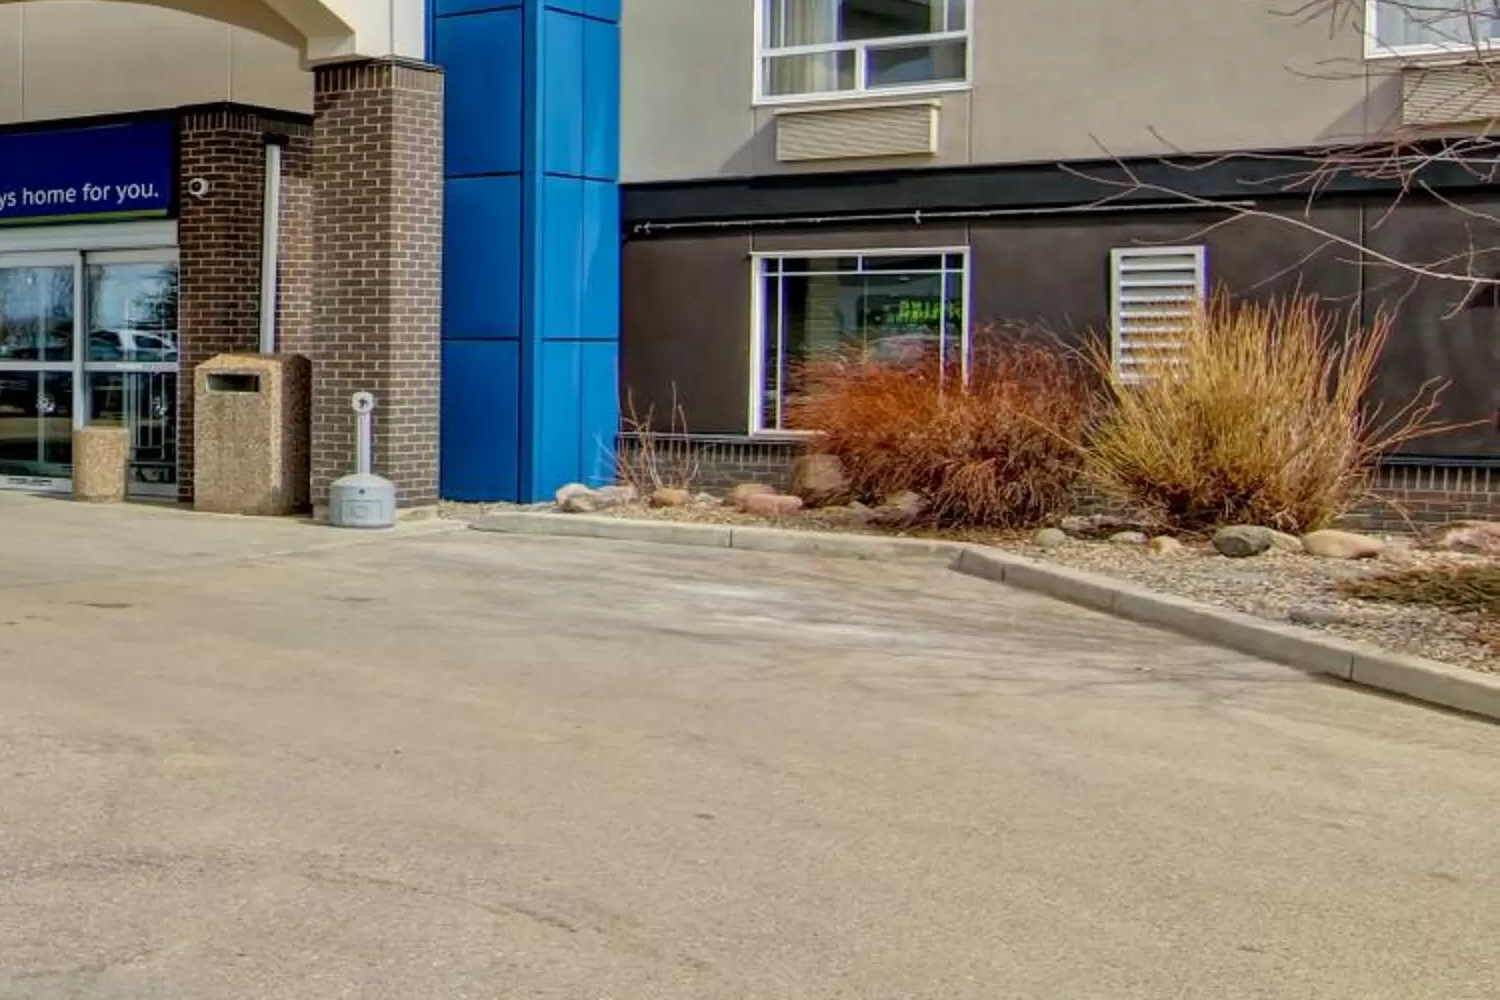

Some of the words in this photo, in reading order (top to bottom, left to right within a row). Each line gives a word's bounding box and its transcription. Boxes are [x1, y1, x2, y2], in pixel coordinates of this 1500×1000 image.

[22, 185, 77, 206] home
[83, 182, 111, 202] for
[116, 181, 160, 202] you.
